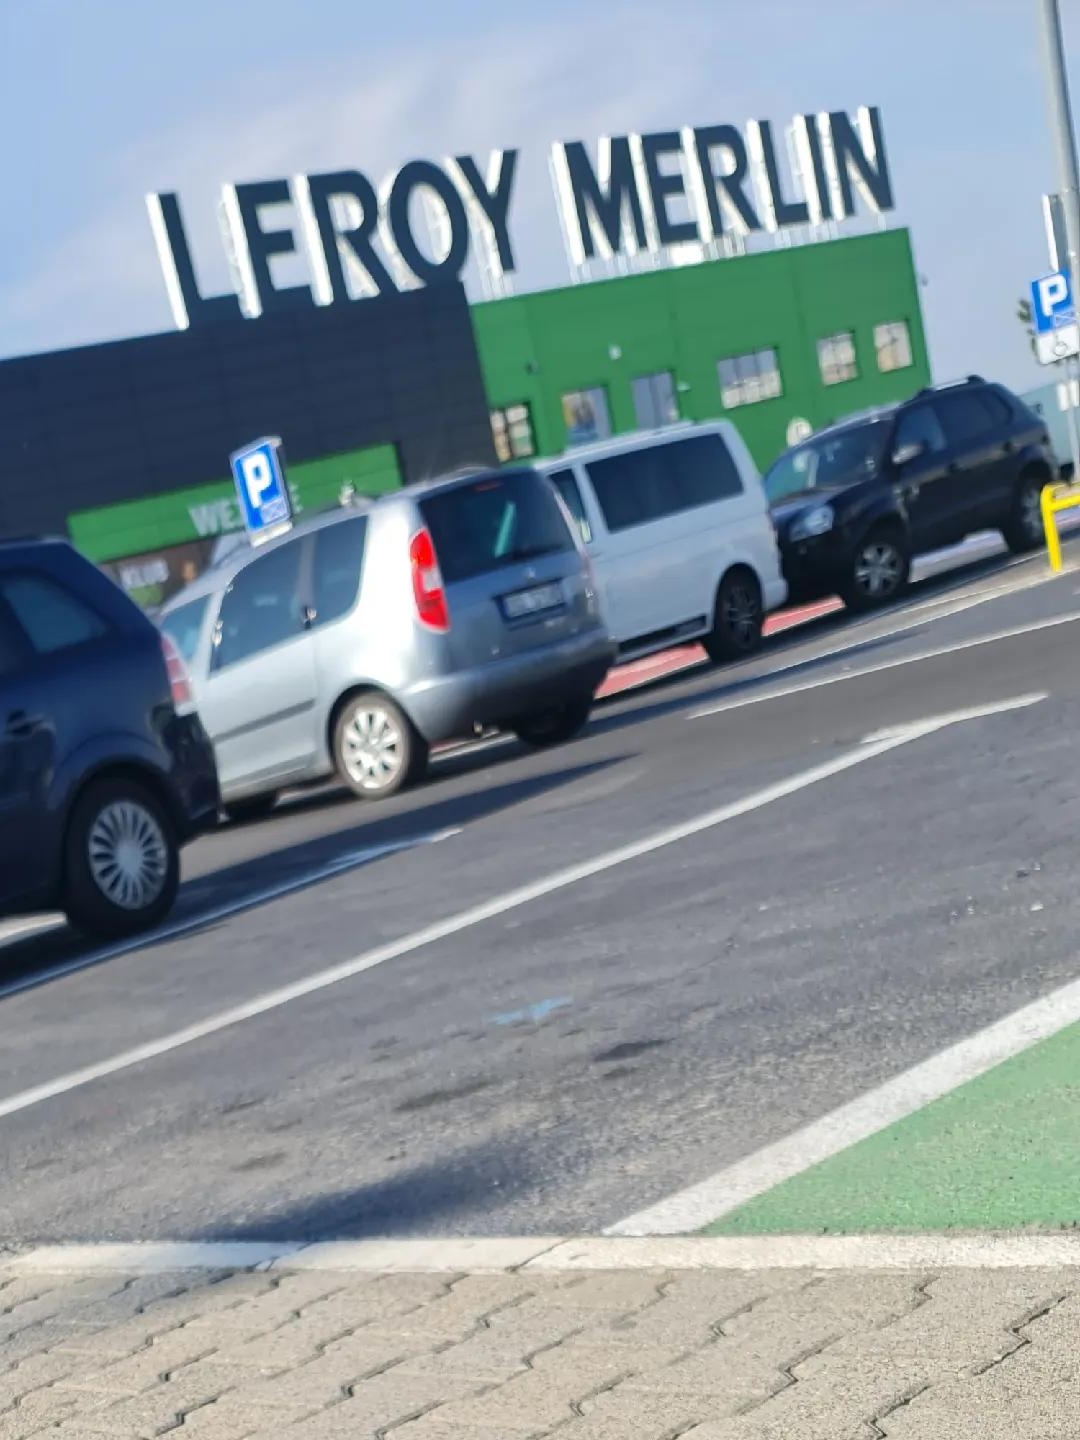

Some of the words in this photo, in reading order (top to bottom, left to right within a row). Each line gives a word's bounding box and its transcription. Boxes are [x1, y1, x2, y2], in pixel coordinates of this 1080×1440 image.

[148, 149, 518, 328] LEROY
[552, 106, 894, 262] MERLIN
[1039, 274, 1068, 317] P
[242, 452, 273, 508] P
